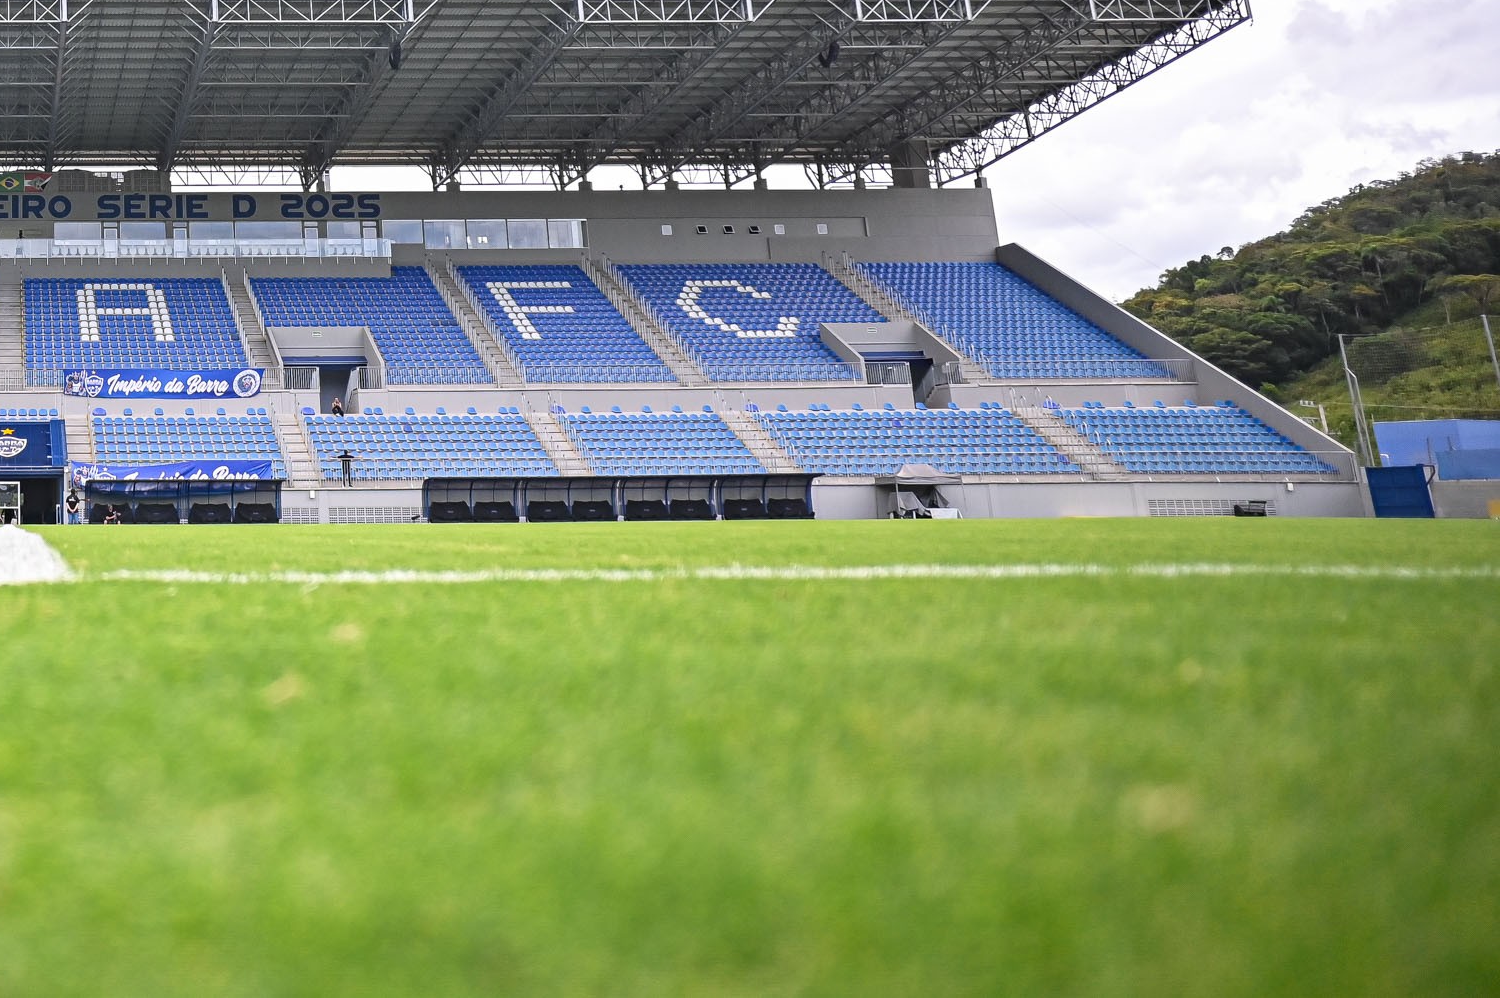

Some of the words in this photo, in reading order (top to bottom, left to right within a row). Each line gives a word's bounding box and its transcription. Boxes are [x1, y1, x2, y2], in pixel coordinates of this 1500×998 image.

[232, 195, 257, 218] D
[280, 194, 380, 218] 2025
[107, 374, 162, 396] Império
[164, 377, 184, 393] da
[186, 374, 229, 396] Barra
